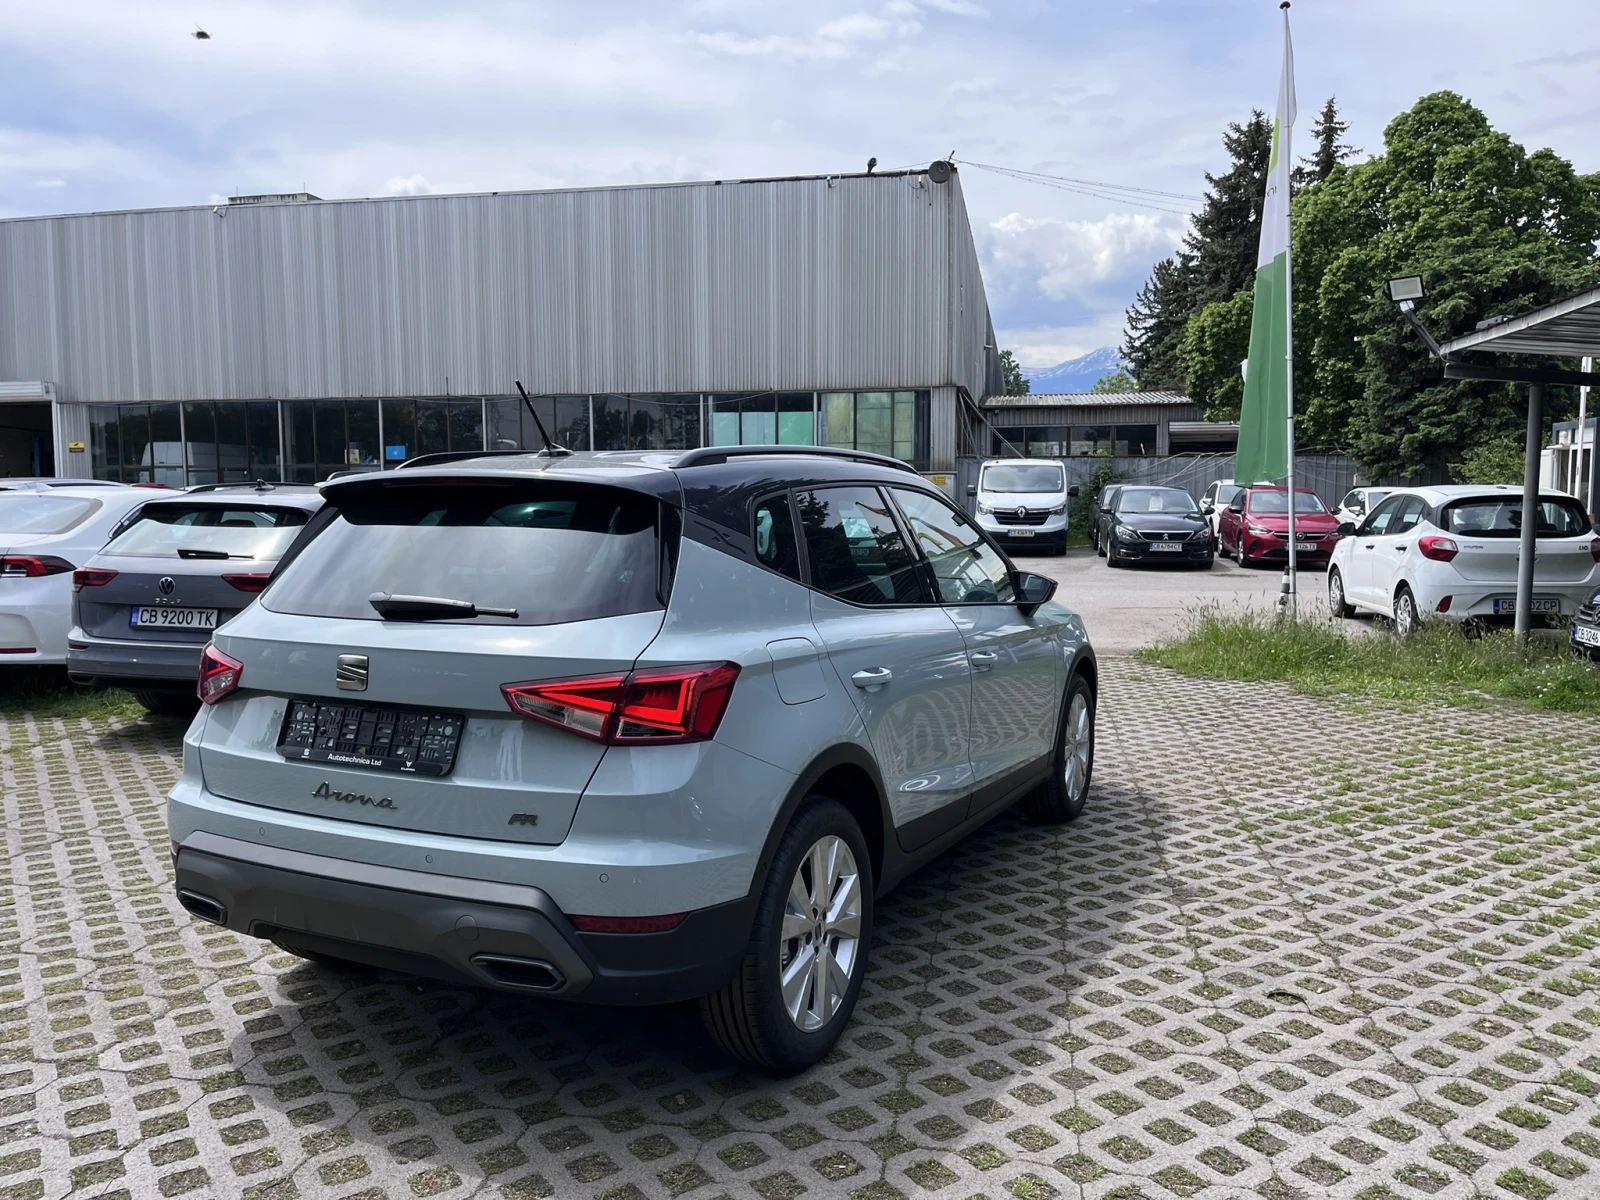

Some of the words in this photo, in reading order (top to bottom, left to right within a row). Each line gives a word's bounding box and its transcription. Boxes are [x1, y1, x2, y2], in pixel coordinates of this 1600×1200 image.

[1501, 601, 1515, 611] CB
[1543, 601, 1557, 611] CP
[140, 609, 158, 624] CB
[161, 609, 194, 625] 9200
[197, 611, 214, 626] TK
[1578, 628, 1584, 640] CB
[1585, 629, 1599, 643] 3246
[327, 753, 370, 765] Autotechnica
[311, 780, 398, 809] Arona
[507, 812, 538, 827] FR
